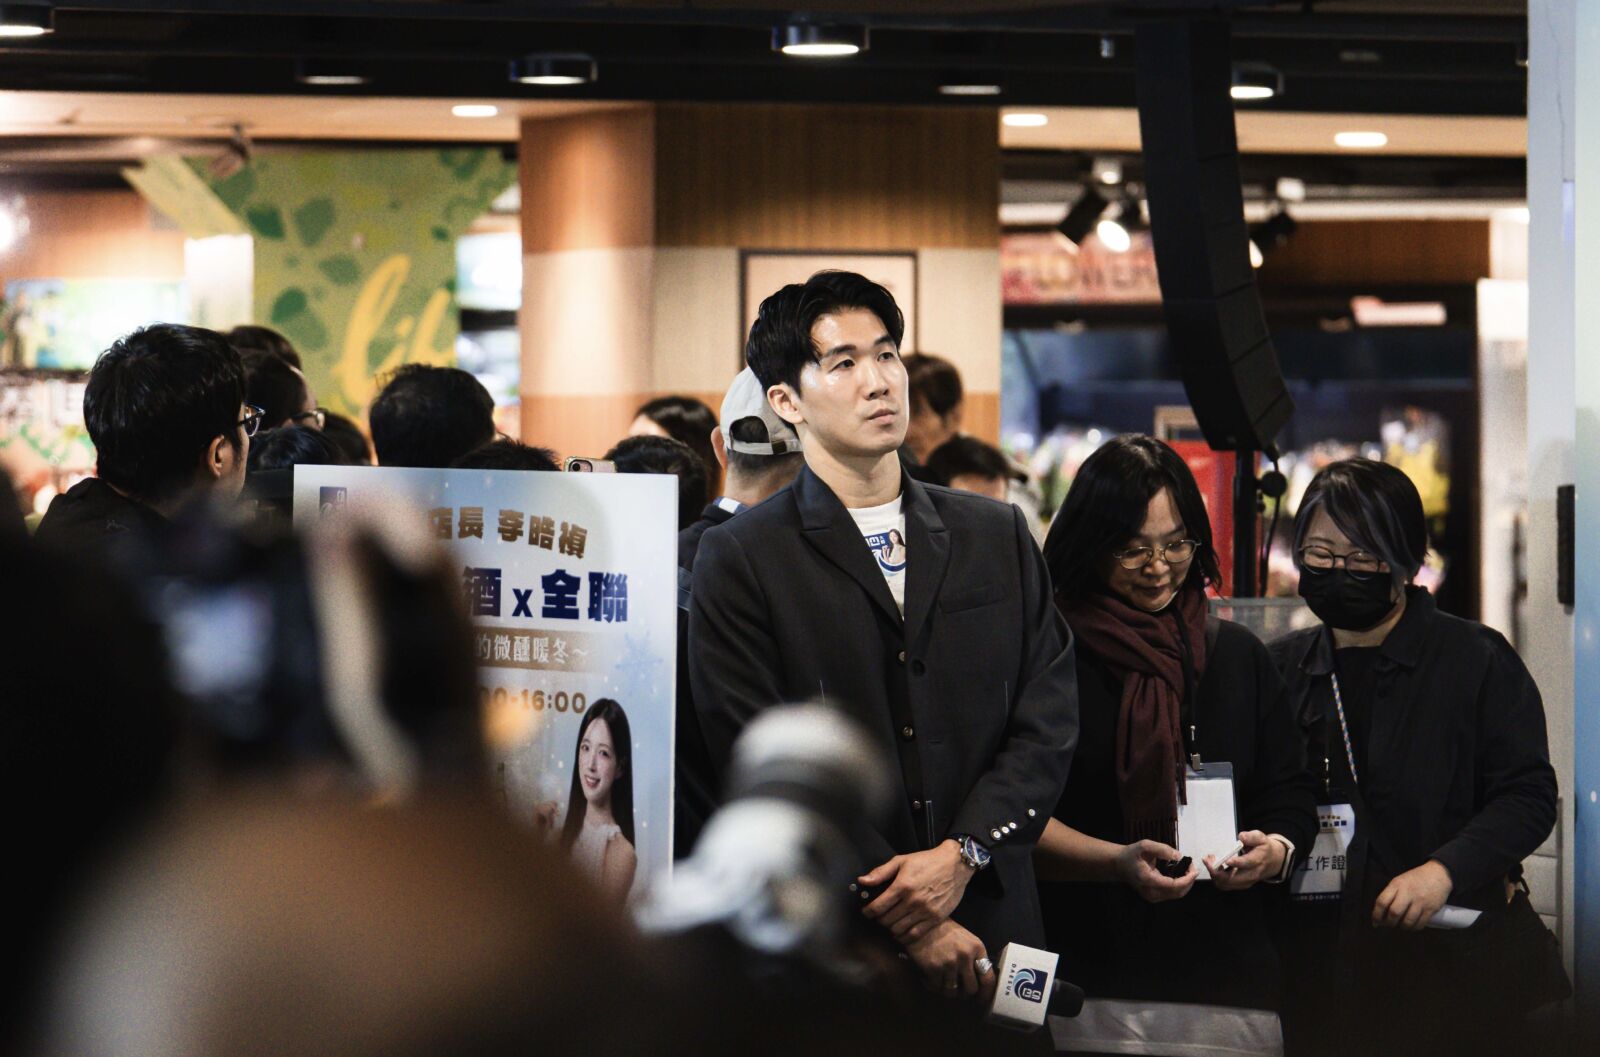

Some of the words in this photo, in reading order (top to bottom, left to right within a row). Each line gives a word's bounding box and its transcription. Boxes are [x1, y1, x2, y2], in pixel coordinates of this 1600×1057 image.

[541, 569, 628, 623] 全聯
[1299, 855, 1346, 871] 工作證
[1005, 963, 1017, 996] DAESUN
